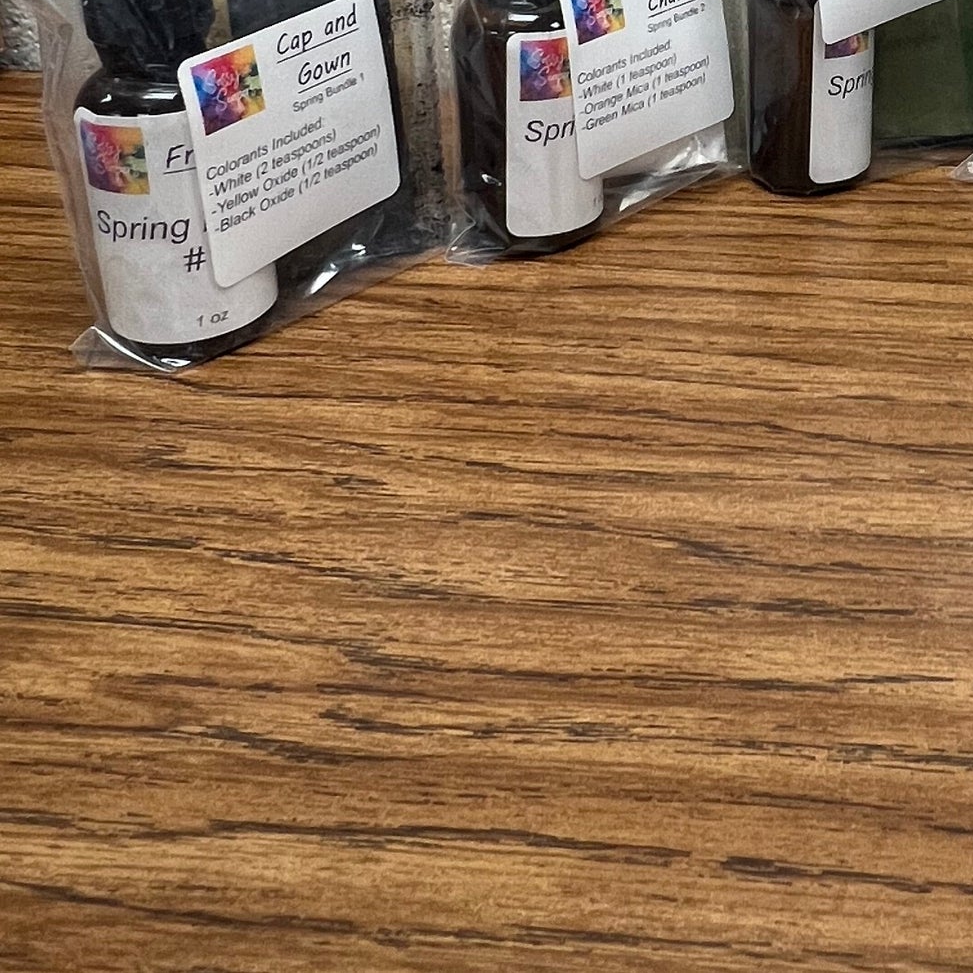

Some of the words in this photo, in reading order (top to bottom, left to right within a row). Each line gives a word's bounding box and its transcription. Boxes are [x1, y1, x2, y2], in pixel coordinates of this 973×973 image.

[276, 30, 313, 54] Cap
[324, 2, 358, 36] and
[647, 16, 673, 33] Spring
[674, 7, 699, 23] Bundle
[298, 50, 351, 86] Gown
[577, 58, 627, 85] Colorants
[578, 80, 613, 100] -White
[616, 73, 626, 89] (1
[629, 52, 677, 81] teaspoon)
[580, 92, 623, 115] -Orange
[626, 81, 649, 99] Mica
[652, 74, 661, 90] (1
[664, 55, 710, 83] teaspoon)
[292, 91, 324, 113] Spring
[325, 76, 358, 97] Bundle
[581, 110, 618, 131] -Green
[621, 99, 645, 116] Mica
[647, 92, 657, 108] (1
[660, 72, 706, 100] teaspoon)
[524, 115, 576, 147] Spri
[206, 144, 269, 181] Colorants
[209, 170, 252, 197] -White
[256, 161, 269, 179] (2
[271, 128, 337, 170] teaspoons)
[211, 186, 259, 215] -Yellow
[263, 167, 298, 192] Oxide
[301, 153, 324, 175] (1/2
[327, 124, 381, 161] teaspoon)
[215, 207, 256, 233] -Black
[259, 188, 295, 212] Oxide
[298, 172, 321, 195] (1/2
[324, 142, 378, 178] teaspoon)
[97, 210, 190, 244] Spring
[197, 315, 204, 327] 1
[210, 310, 229, 324] oz
